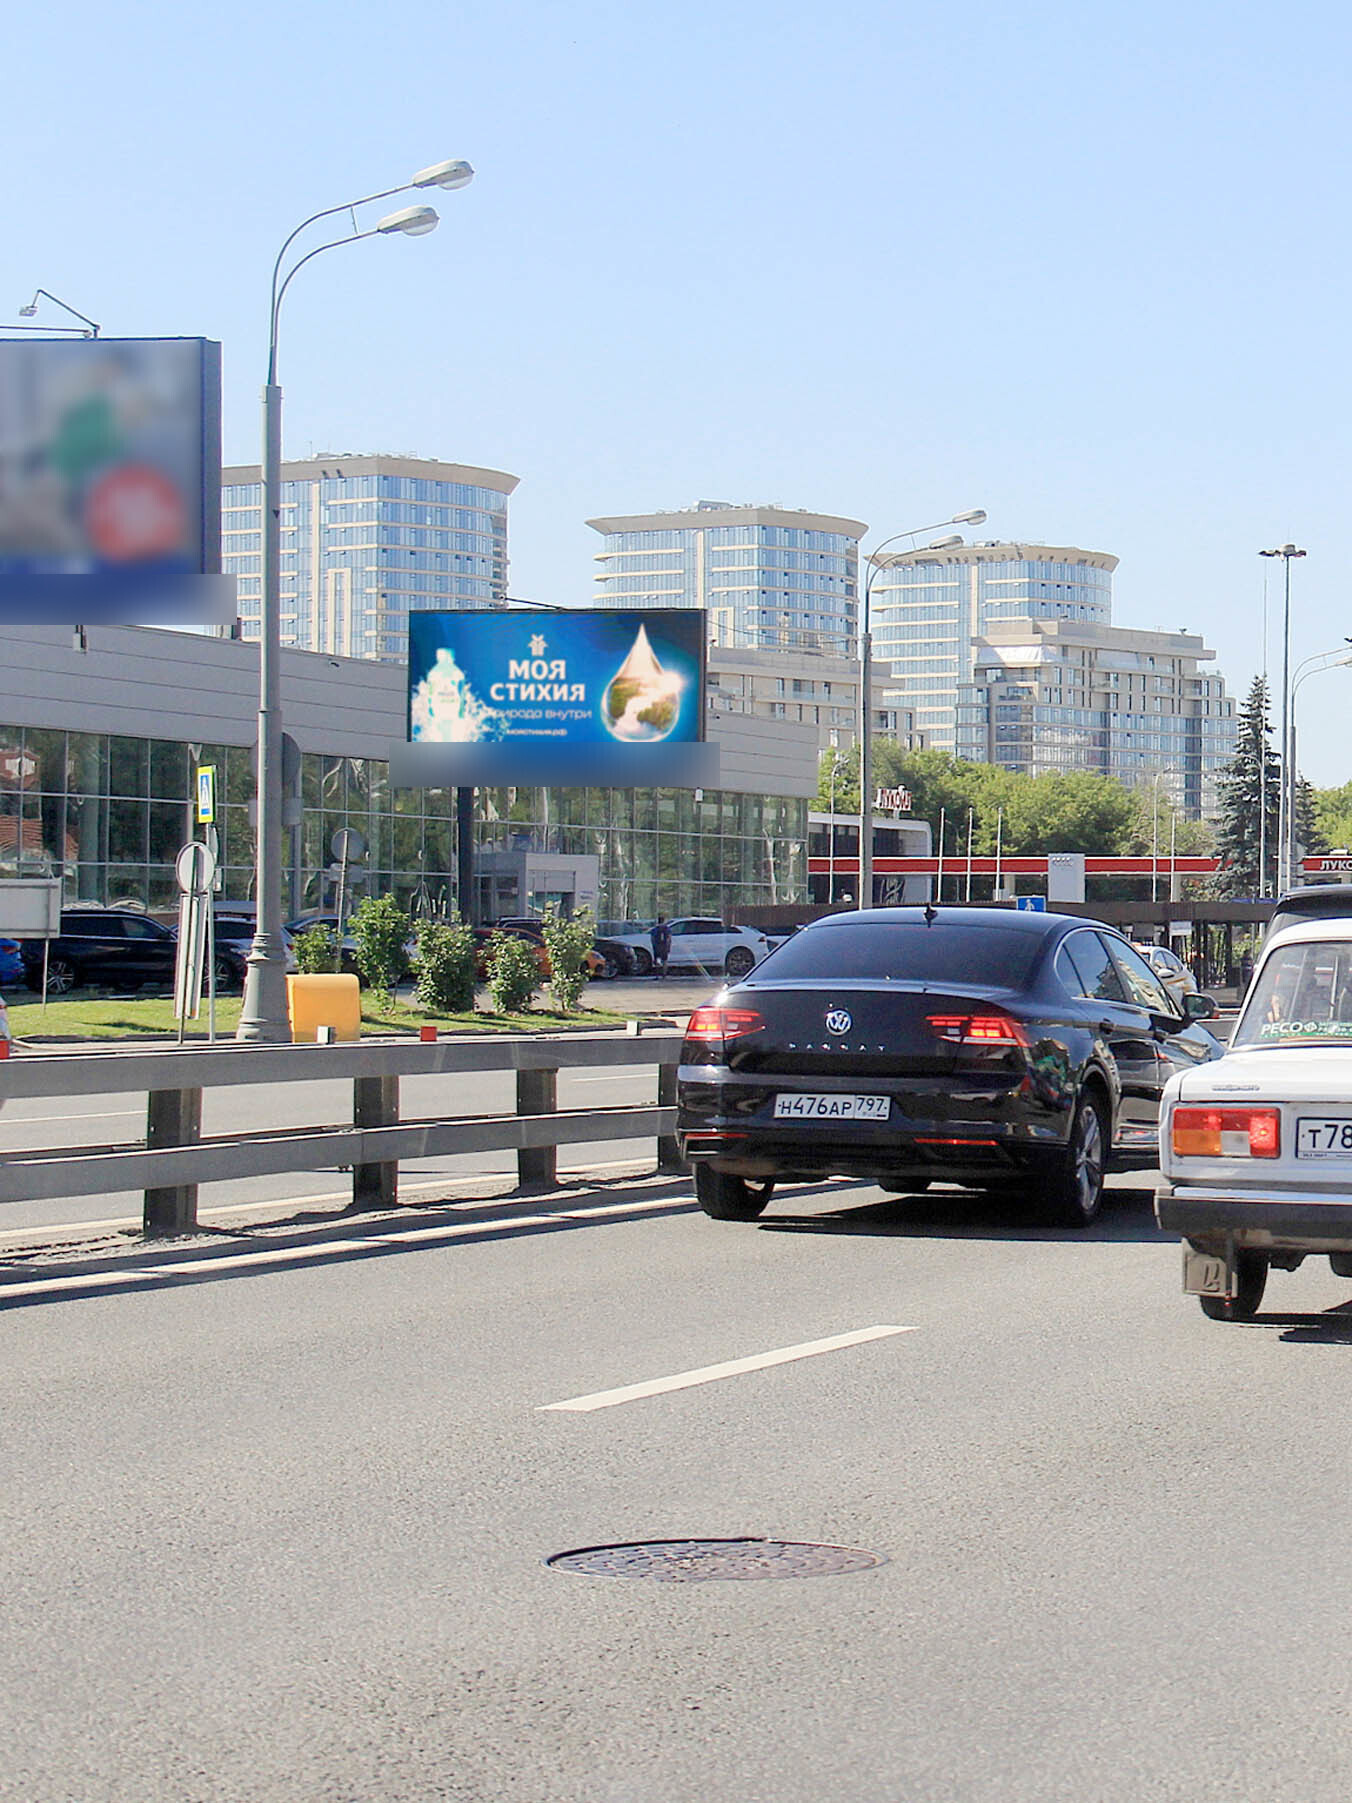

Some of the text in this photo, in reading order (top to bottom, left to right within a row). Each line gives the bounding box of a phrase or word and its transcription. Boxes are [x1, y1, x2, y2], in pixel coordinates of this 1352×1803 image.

[508, 660, 566, 680] МОЯ
[490, 683, 586, 701] СТИХИЯ
[545, 708, 593, 720] внутри
[780, 1097, 885, 1115] Н476АР 797
